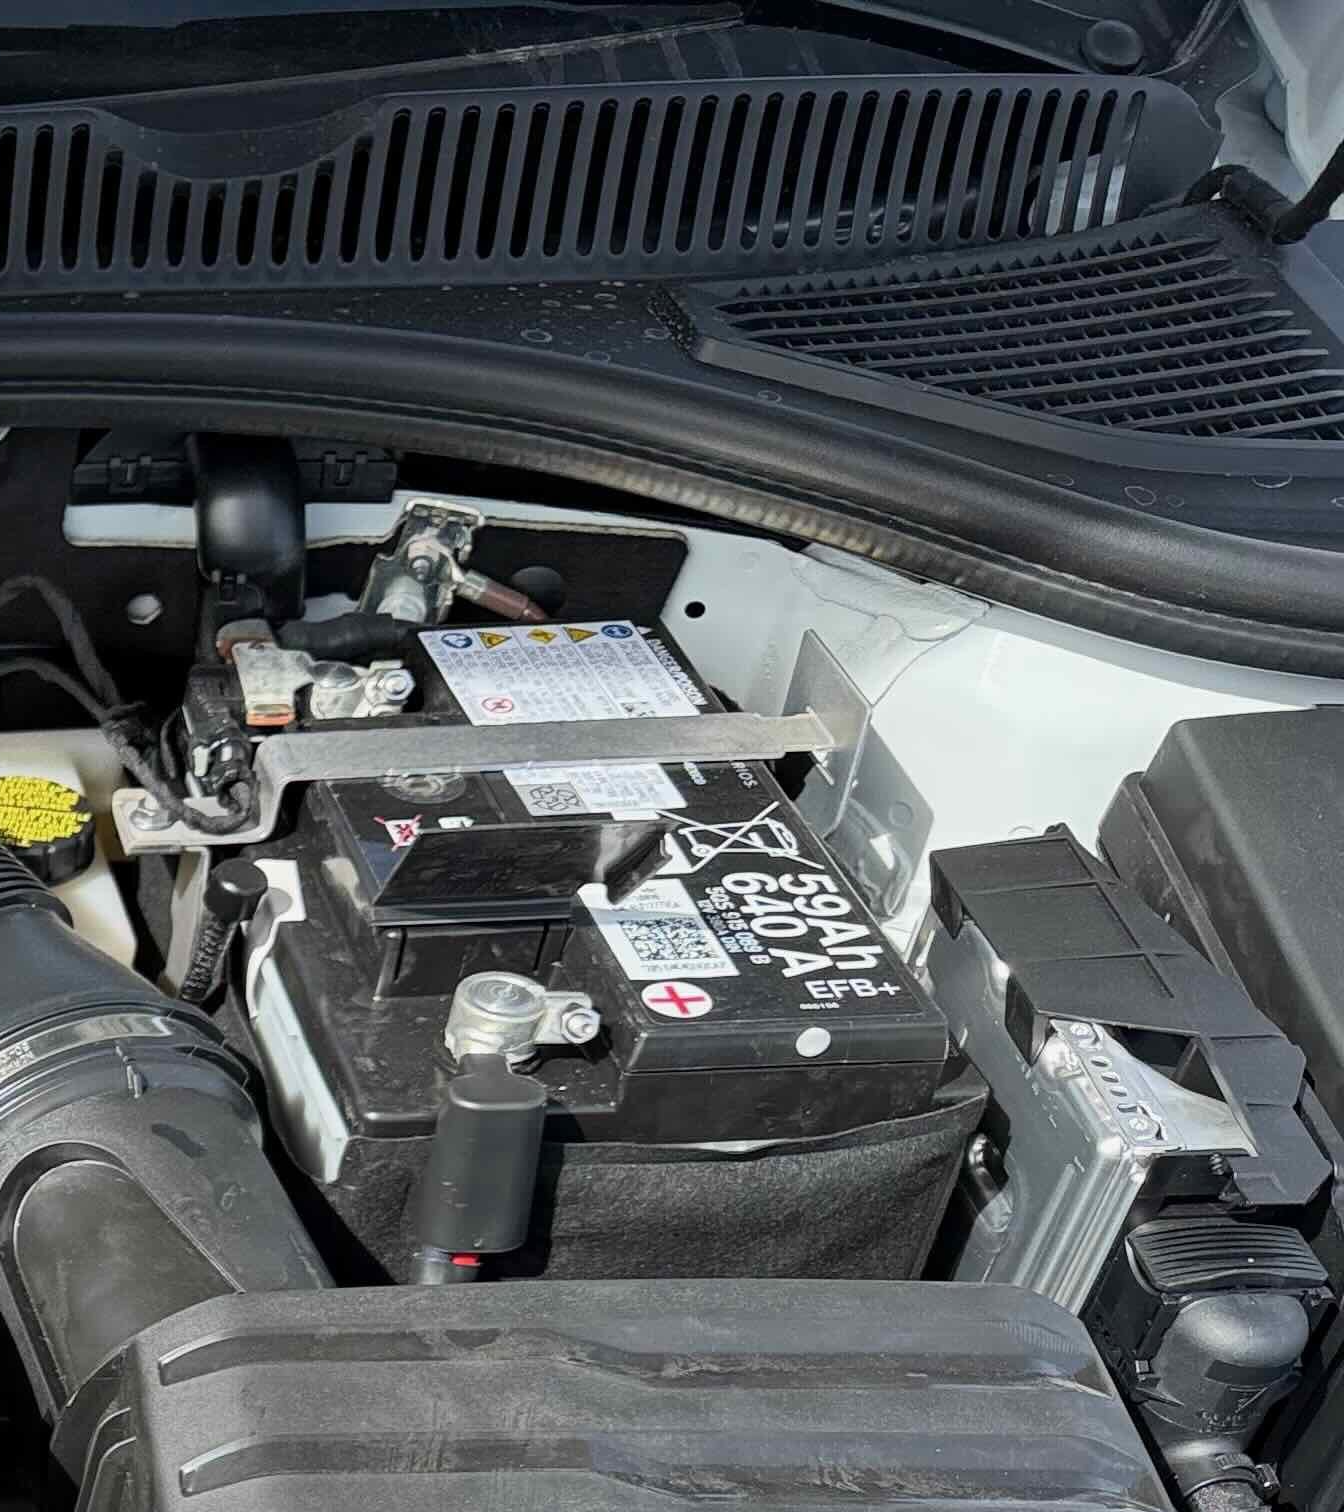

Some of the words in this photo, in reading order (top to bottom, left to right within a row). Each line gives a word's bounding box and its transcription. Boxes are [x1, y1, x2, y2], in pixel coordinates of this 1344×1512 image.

[720, 871, 809, 938] 640
[767, 947, 835, 979] A
[778, 872, 884, 970] 59Ah
[803, 978, 902, 1000] EFB+
